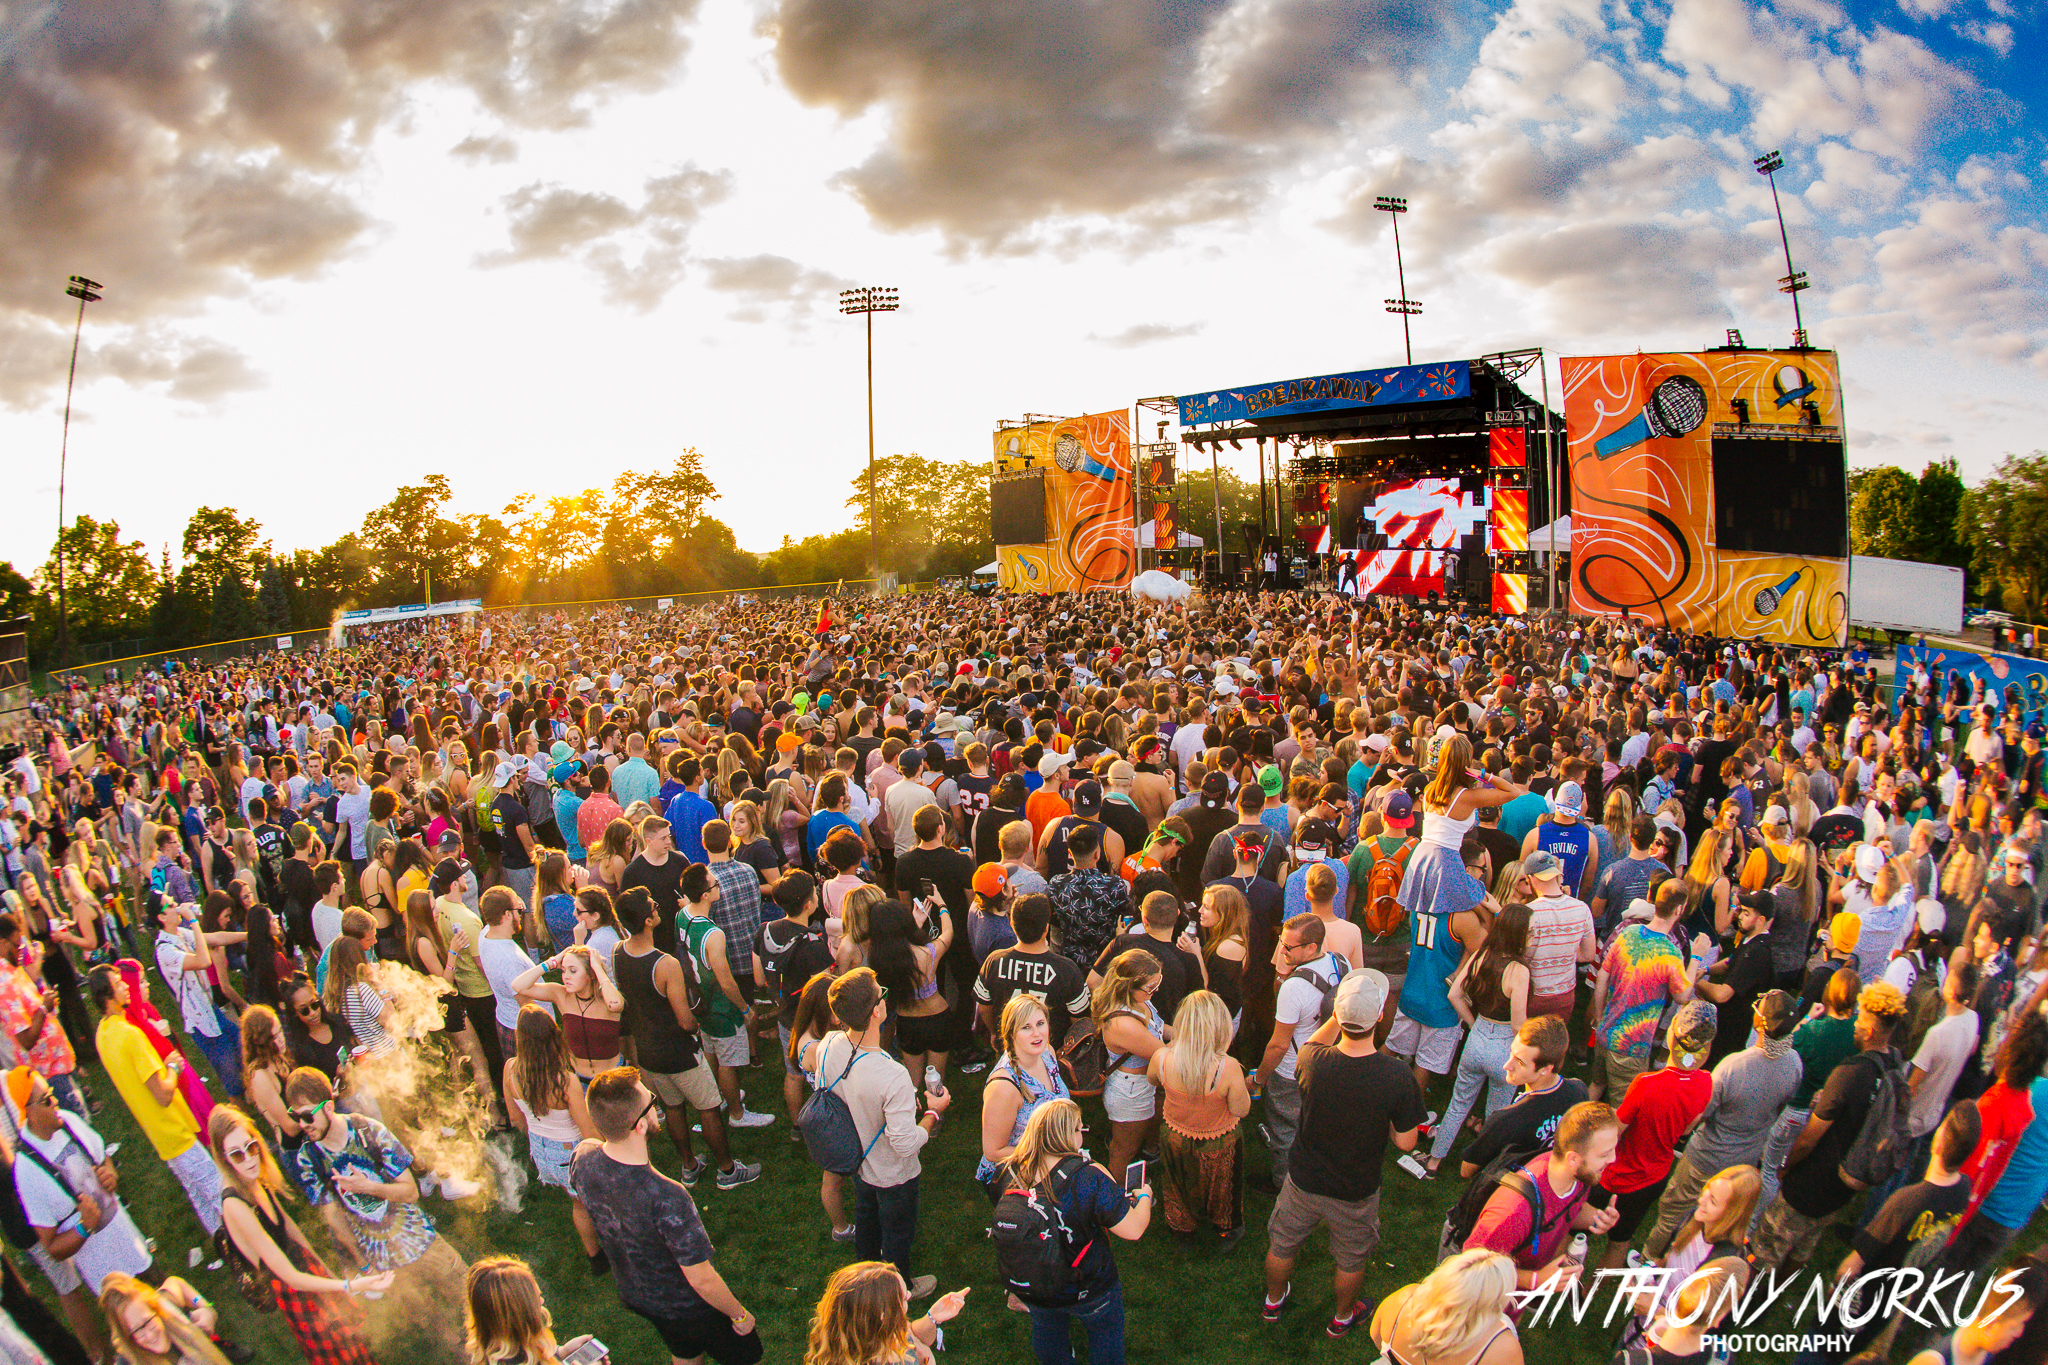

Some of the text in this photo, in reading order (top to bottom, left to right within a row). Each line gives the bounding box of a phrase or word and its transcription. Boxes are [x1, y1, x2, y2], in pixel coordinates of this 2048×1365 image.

[1244, 377, 1381, 416] BREAKAWAY
[1548, 842, 1579, 855] IRVING
[1415, 911, 1438, 950] 11
[998, 957, 1057, 986] LIFTED
